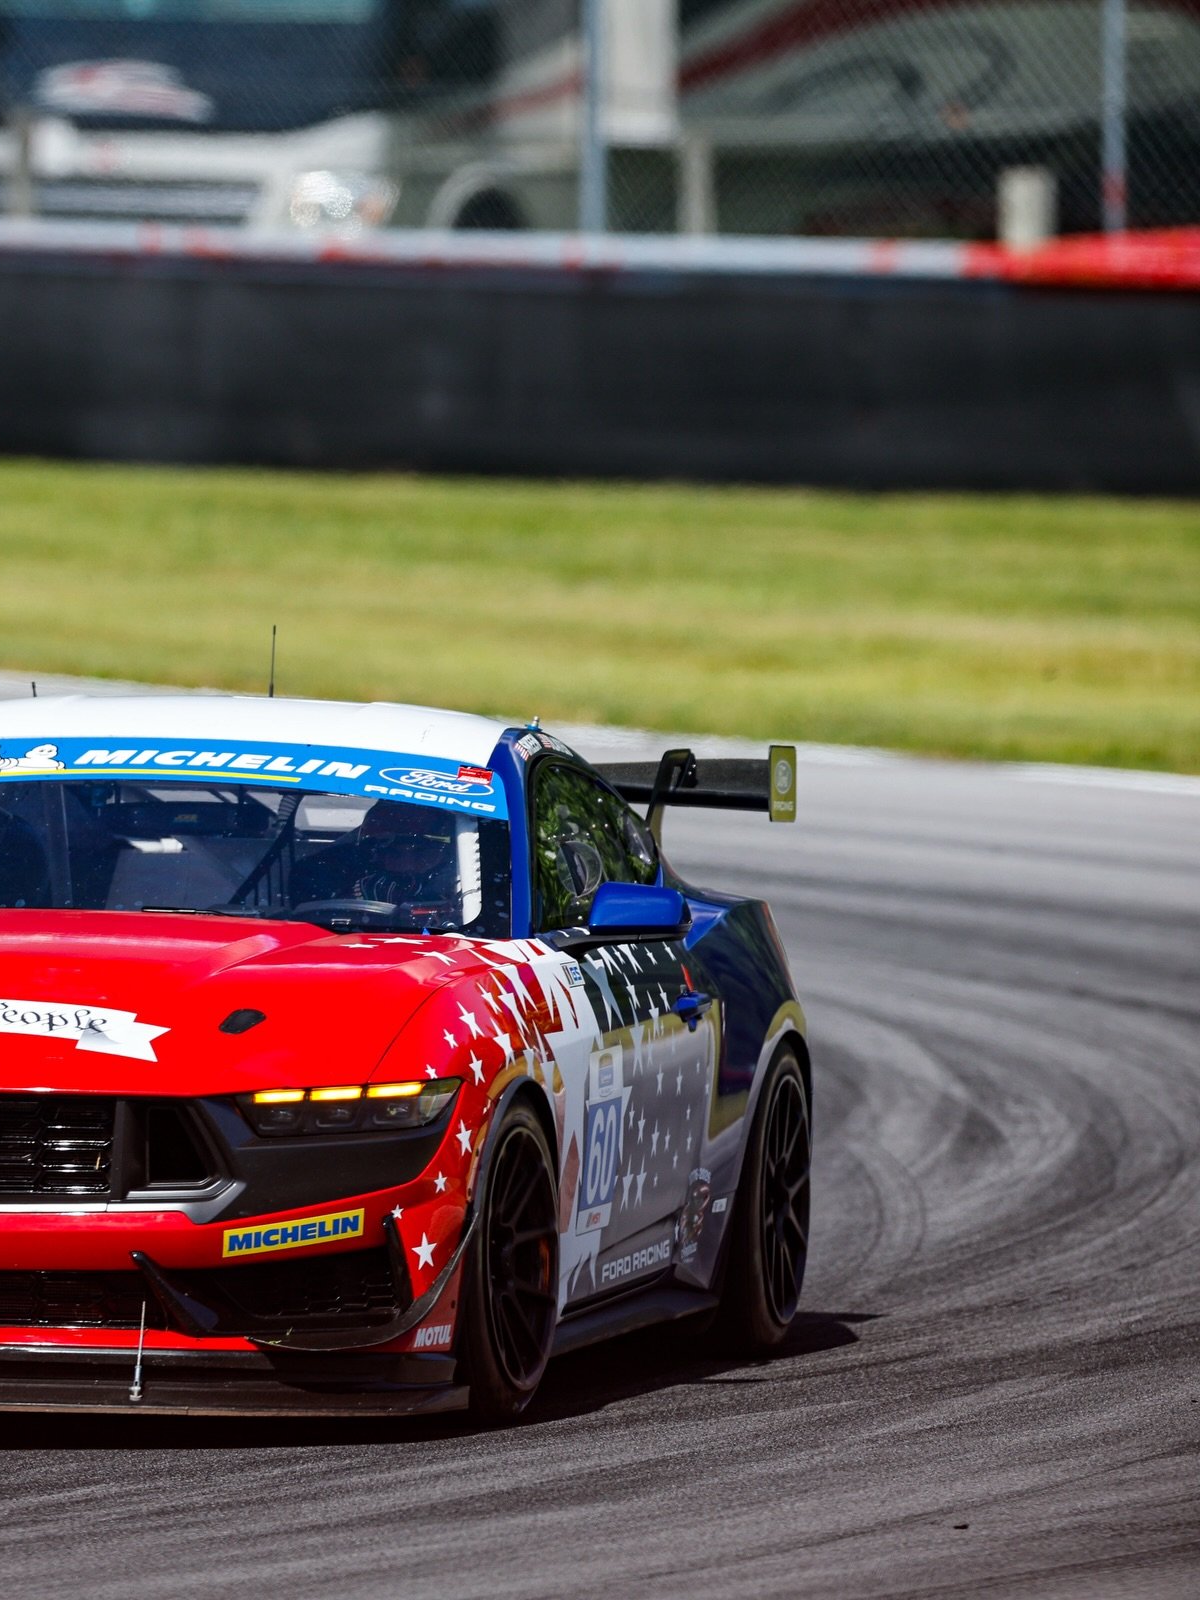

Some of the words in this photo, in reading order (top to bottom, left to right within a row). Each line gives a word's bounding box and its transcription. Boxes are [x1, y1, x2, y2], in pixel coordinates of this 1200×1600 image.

[74, 749, 370, 779] MICHELIN
[399, 769, 471, 794] Ford
[364, 784, 496, 813] RACING
[586, 1104, 617, 1205] 60
[228, 1215, 360, 1252] MICHELIN
[601, 1255, 632, 1283] FORD
[632, 1239, 670, 1272] RACING
[413, 1324, 452, 1348] MOTUL
